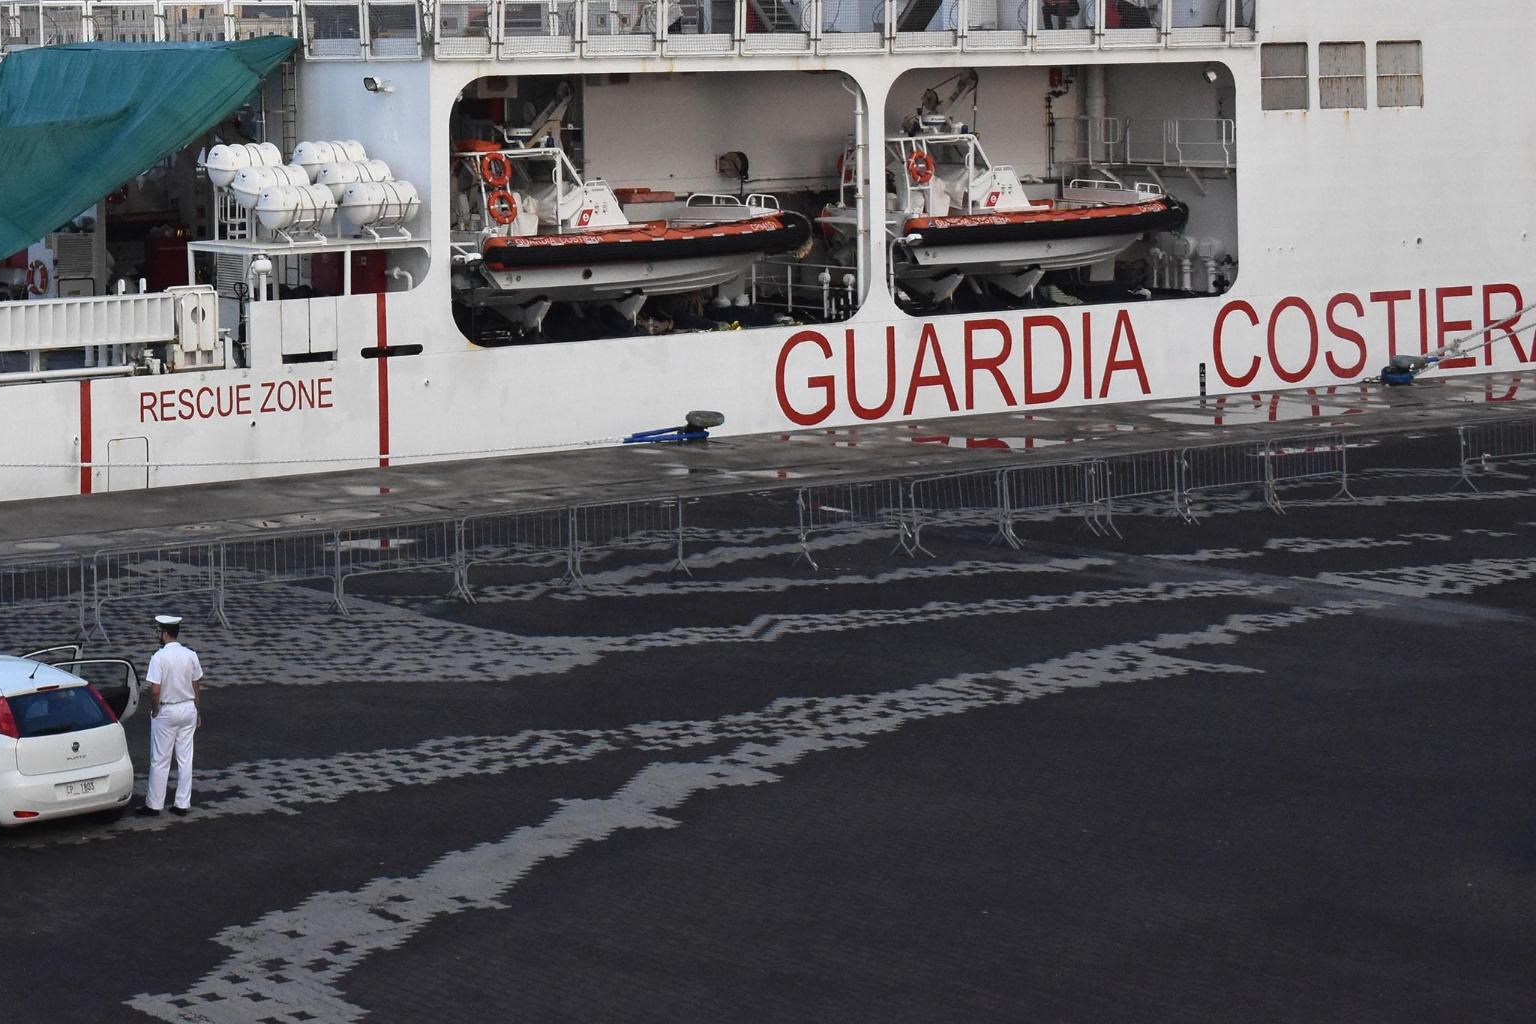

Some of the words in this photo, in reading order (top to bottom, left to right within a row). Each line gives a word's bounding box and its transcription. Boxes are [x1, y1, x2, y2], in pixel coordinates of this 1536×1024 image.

[140, 384, 252, 423] RESCUE
[260, 377, 333, 414] ZONE
[774, 309, 1152, 426] GUARDIA
[1212, 283, 1536, 389] COSTIER
